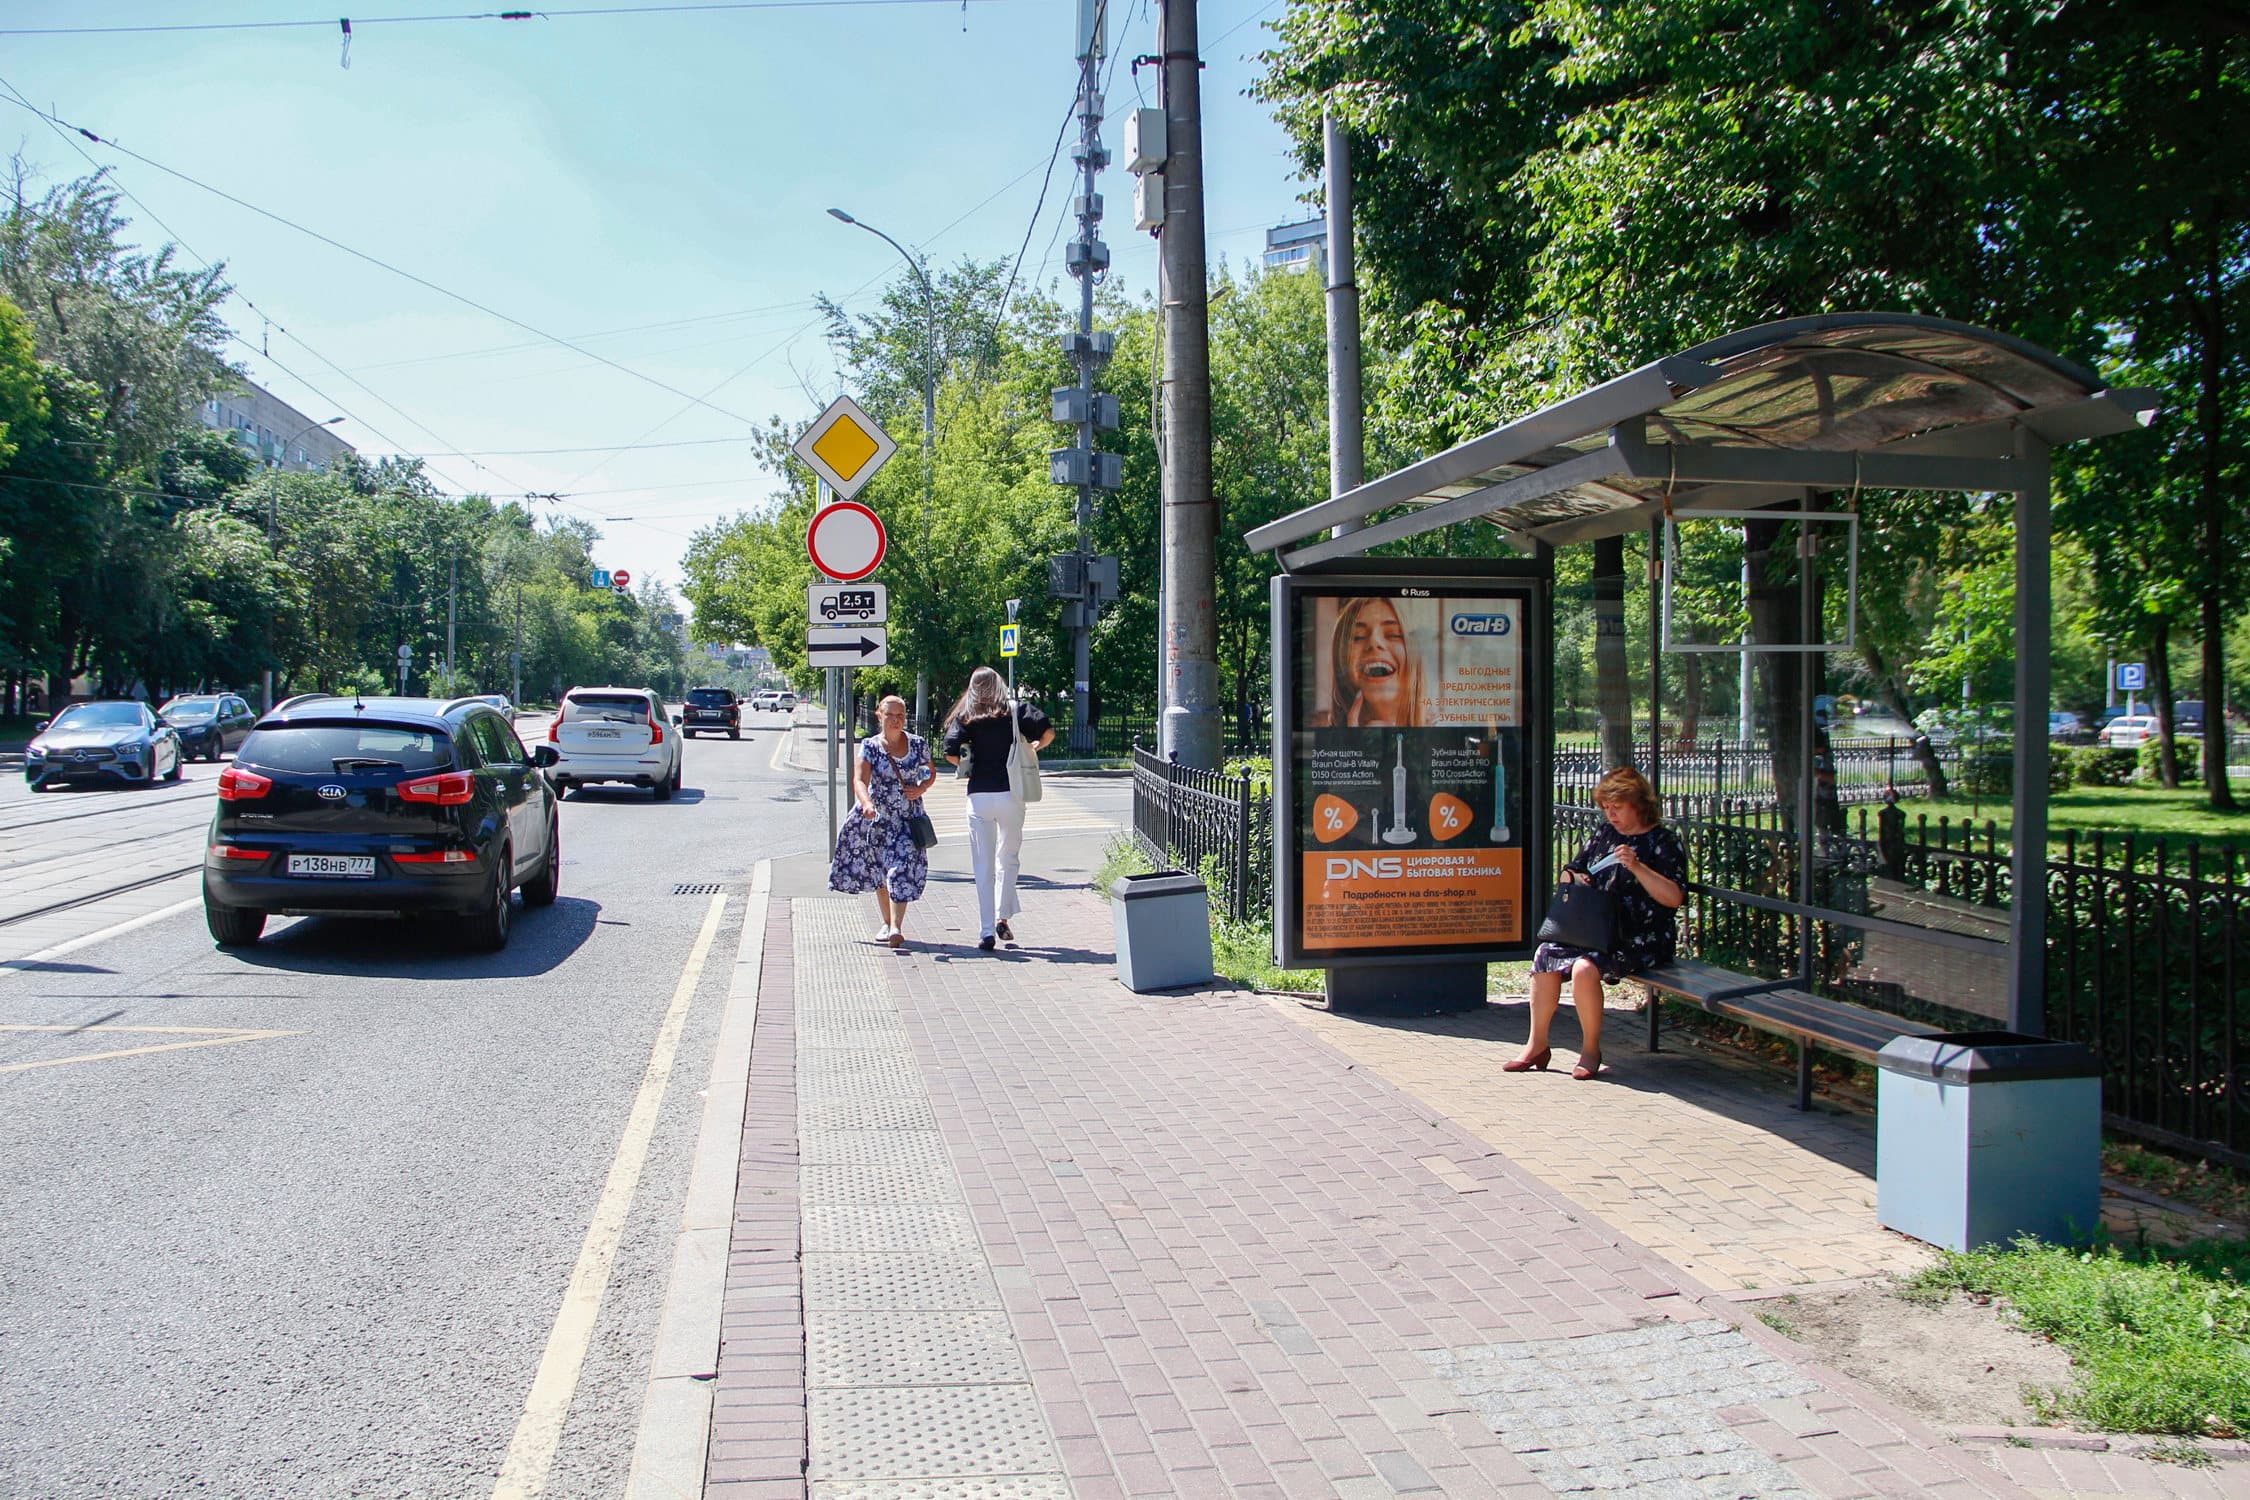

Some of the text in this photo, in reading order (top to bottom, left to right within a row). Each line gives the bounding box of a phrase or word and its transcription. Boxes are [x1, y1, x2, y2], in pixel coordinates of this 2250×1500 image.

[1410, 588, 1430, 597] Russ
[843, 595, 861, 607] 2,5
[1454, 617, 1506, 633] Oral-B
[1458, 667, 1511, 676] ВЫГОДНЫЕ
[2124, 666, 2140, 686] P
[1440, 682, 1511, 691] ПРЕДЛОЖЕНИЯ
[1435, 698, 1511, 706] ЭЛЕКТРИЧЕСКИЕ
[1439, 713, 1475, 722] ЗУБНЫЕ
[1311, 749, 1363, 759] Зубная щетка
[1431, 748, 1457, 758] Зубная
[1311, 760, 1333, 768] Braun
[1334, 760, 1357, 768] Oral-B
[1431, 759, 1452, 767] Braun
[1453, 759, 1474, 767] Oral-B
[1331, 771, 1351, 779] Cross
[350, 858, 371, 869] 777
[1407, 856, 1475, 867] ЦИФРОВАЯ И
[1326, 857, 1403, 880] DNS
[1407, 866, 1502, 878] БЫТОВАЯ ТЕХНИКА
[1343, 888, 1477, 900] Подробности на dns-shop.ru
